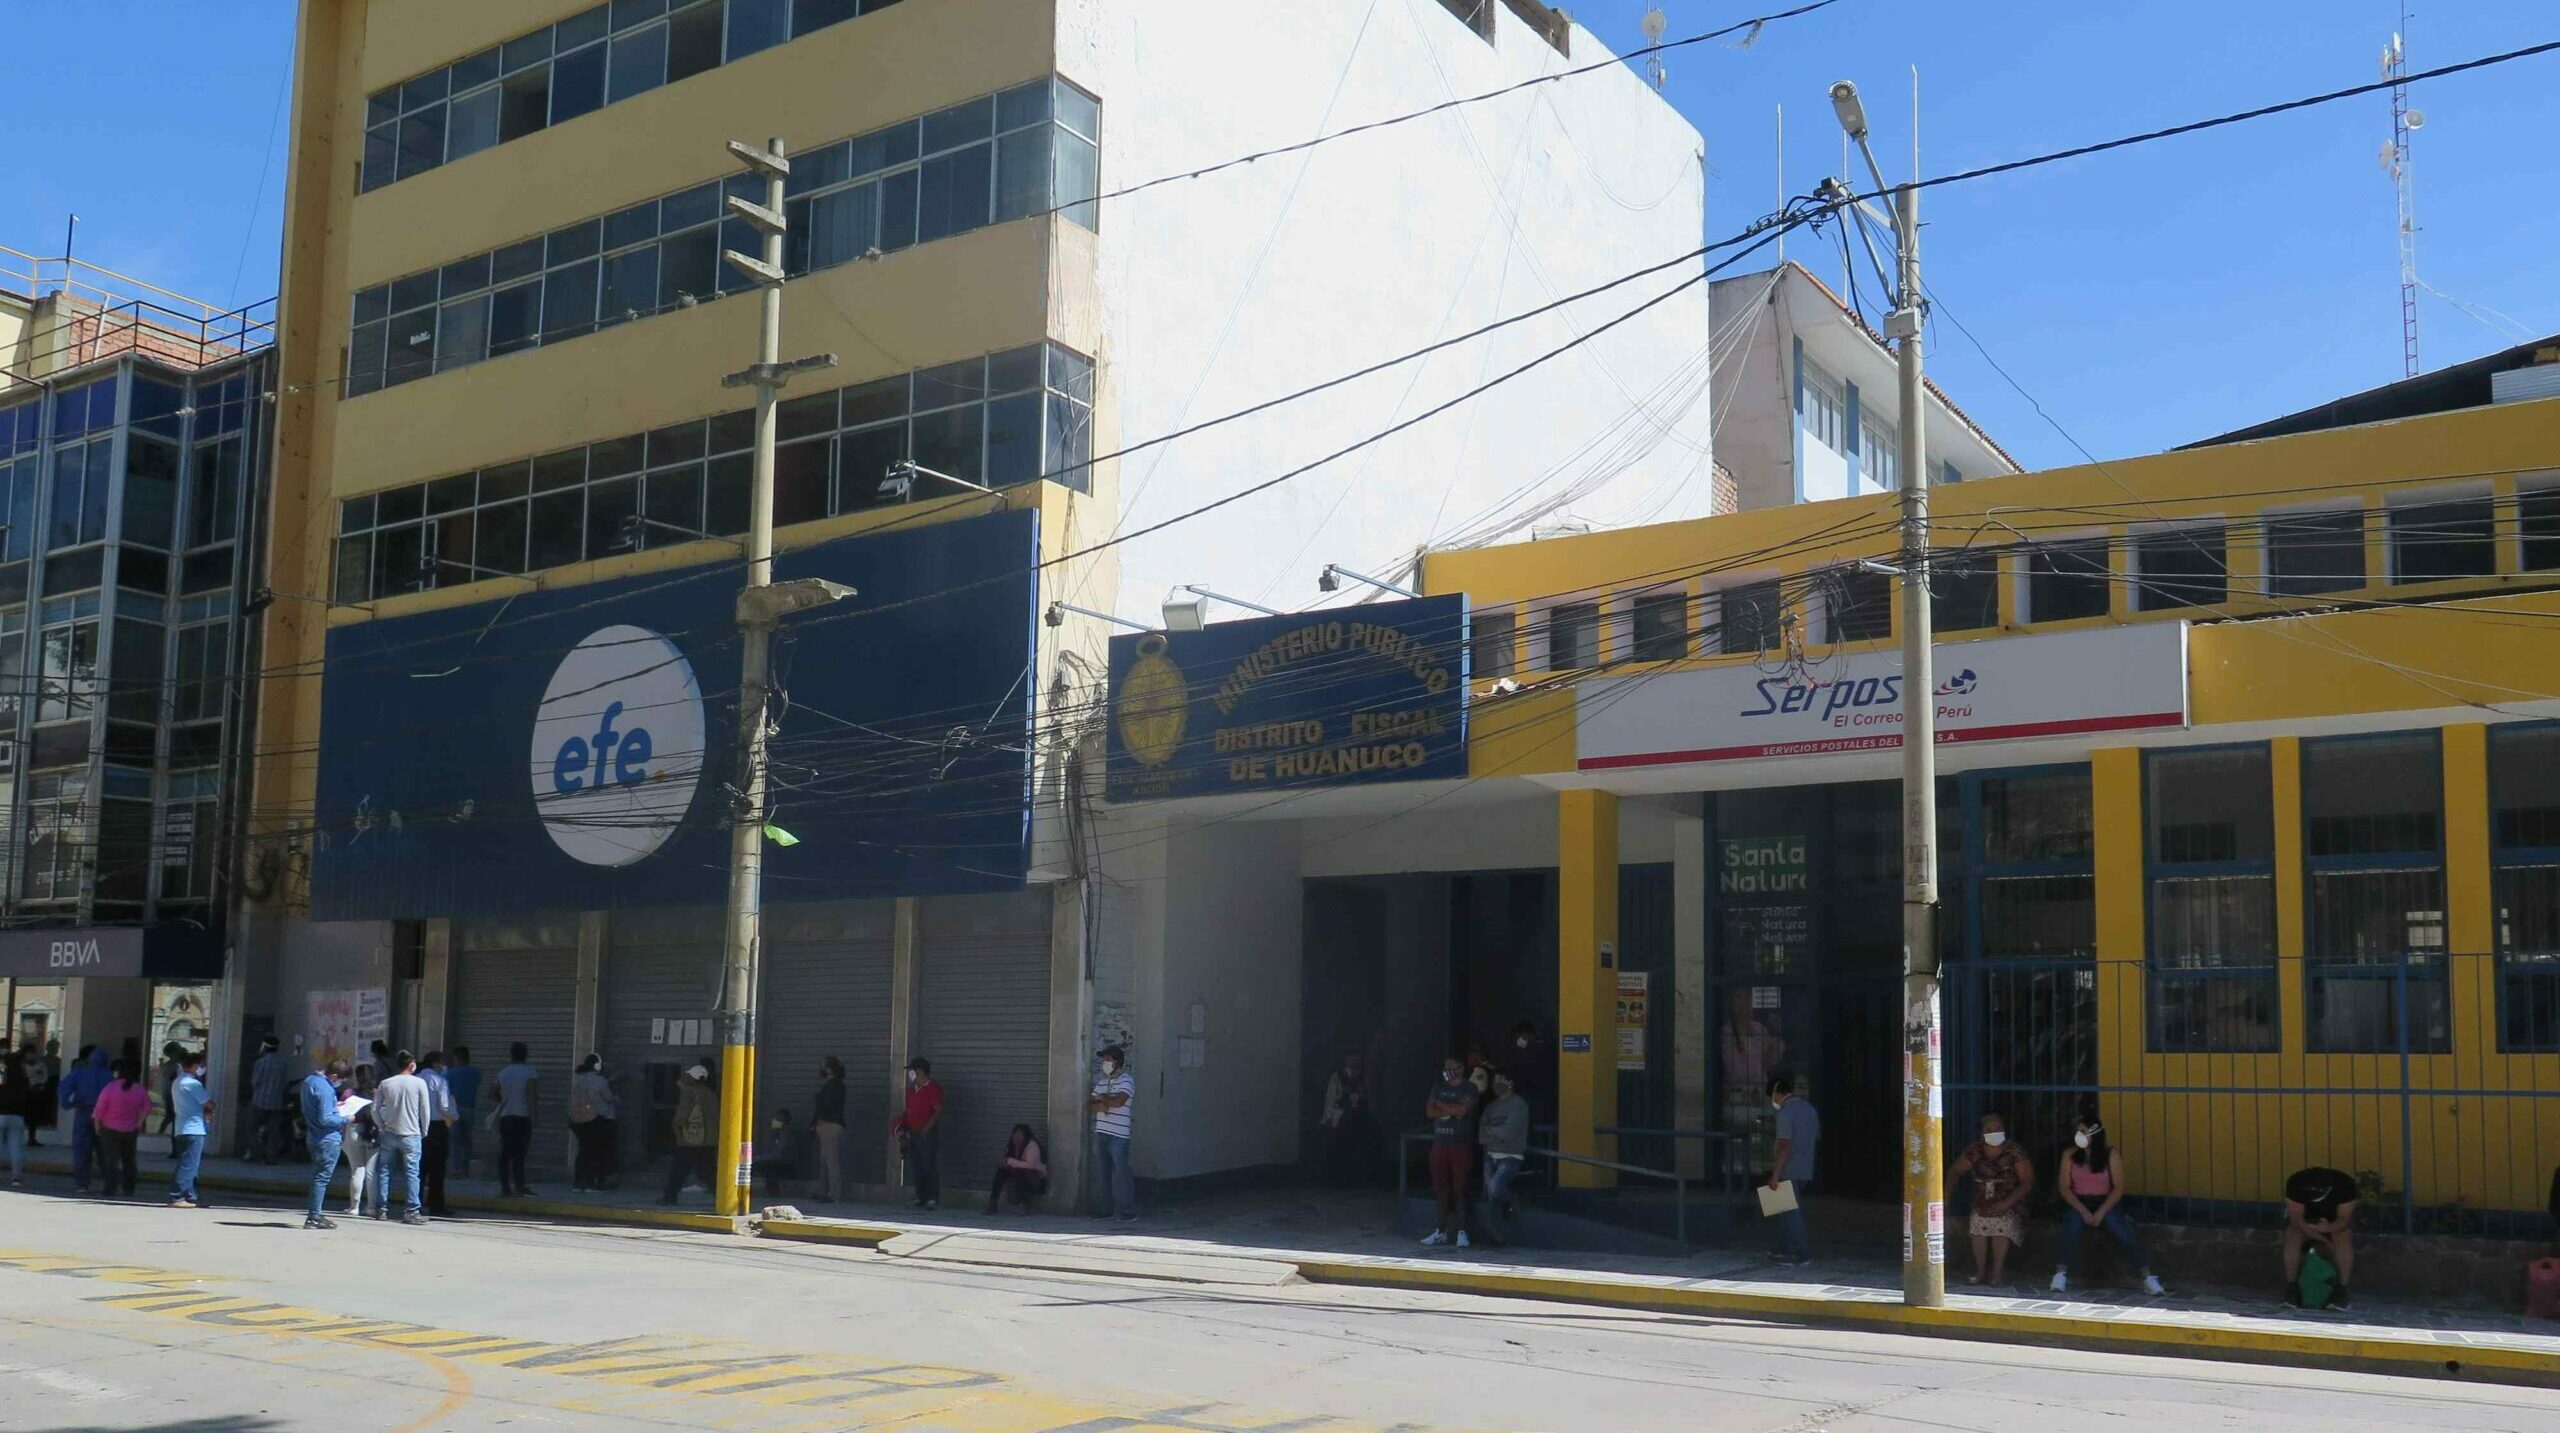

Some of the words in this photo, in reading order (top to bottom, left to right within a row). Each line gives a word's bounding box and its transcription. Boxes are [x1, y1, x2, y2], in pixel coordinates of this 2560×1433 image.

[1217, 621, 1343, 715] MINISTERIO
[1740, 676, 1903, 721] Serpos
[1834, 715, 1848, 728] El
[1854, 711, 1903, 726] Correo
[1936, 704, 1973, 719] Perú
[554, 701, 652, 793] efe
[1215, 720, 1323, 751] DISTRITO
[1351, 708, 1445, 737] FISCAL
[1762, 742, 1818, 756] SERVICIOS
[1820, 739, 1876, 752] POSTALES
[1879, 737, 1899, 748] DEL
[1936, 732, 1959, 743] S.A.
[1229, 756, 1267, 781] DE
[1275, 742, 1425, 778] HUANUCO
[1726, 842, 1805, 868] Santa
[50, 938, 101, 968] BBVA
